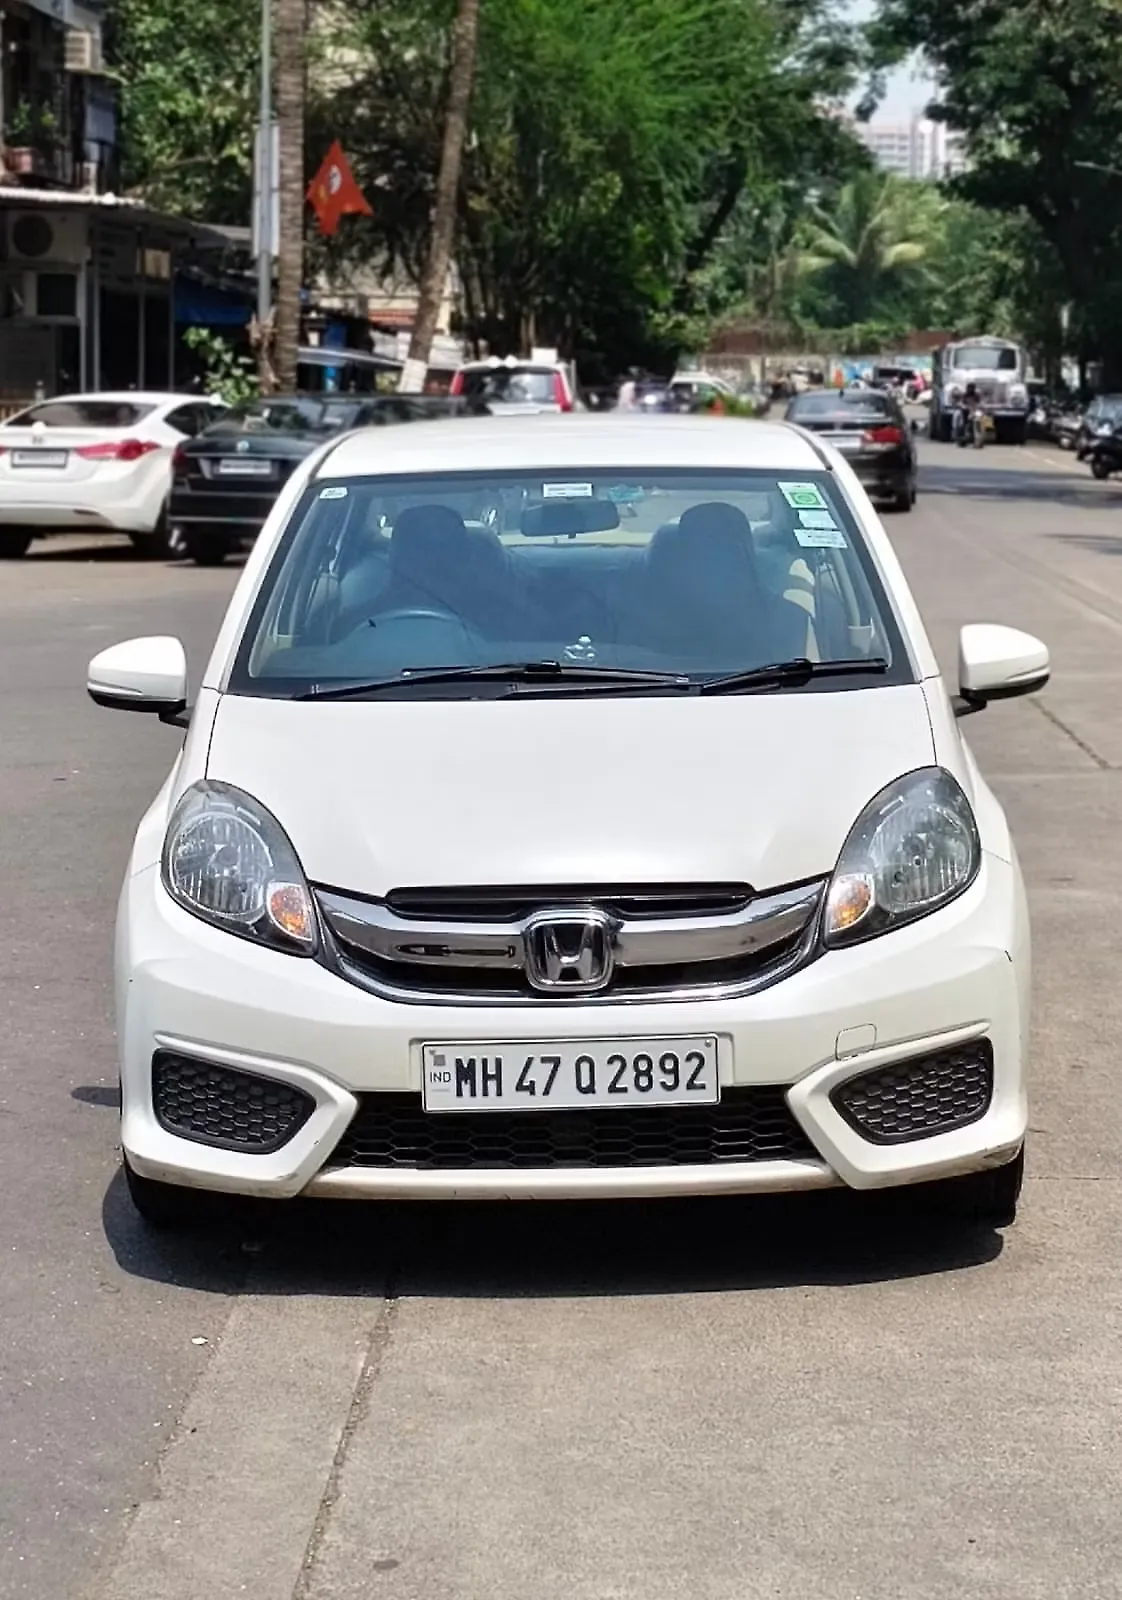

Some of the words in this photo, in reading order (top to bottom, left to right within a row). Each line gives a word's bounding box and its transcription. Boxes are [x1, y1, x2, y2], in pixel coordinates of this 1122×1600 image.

[429, 1071, 451, 1083] IND
[455, 1057, 503, 1097] MH
[515, 1055, 561, 1096] 47
[575, 1054, 596, 1094] Q
[606, 1051, 707, 1094] 2892
